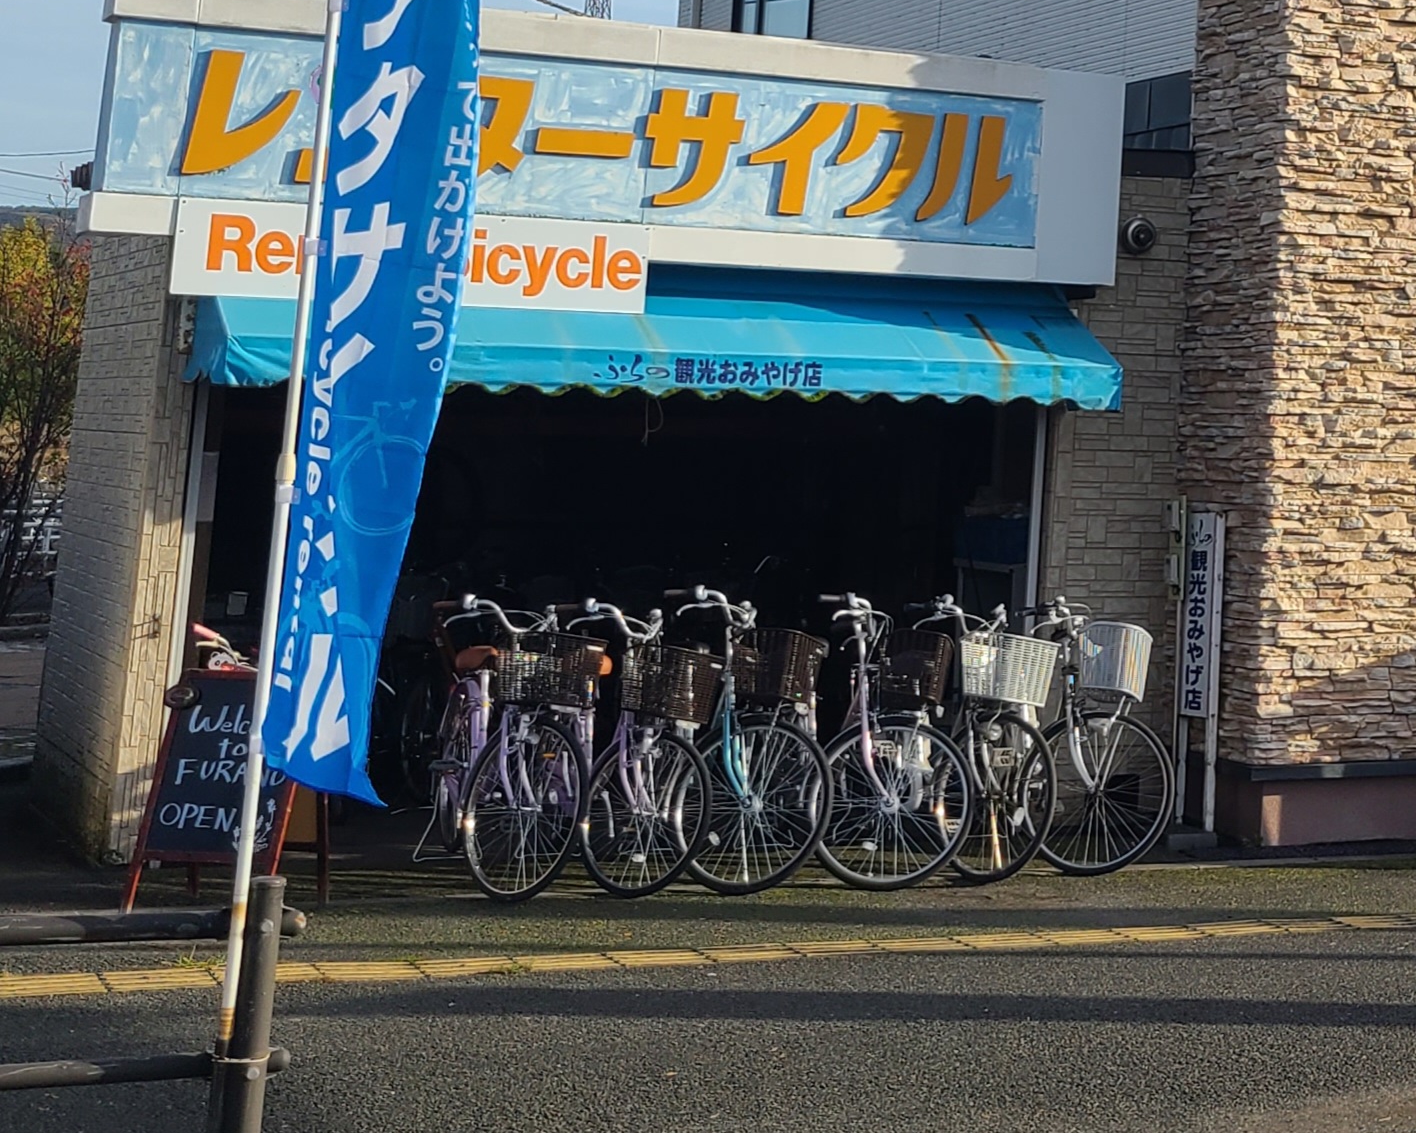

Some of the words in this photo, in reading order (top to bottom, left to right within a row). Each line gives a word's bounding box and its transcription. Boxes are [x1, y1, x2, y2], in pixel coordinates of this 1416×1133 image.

[181, 49, 1013, 226] レターサイクル
[463, 228, 642, 297] icycle
[188, 704, 253, 735] Welc
[218, 738, 248, 759] to
[159, 802, 238, 833] OPEN
